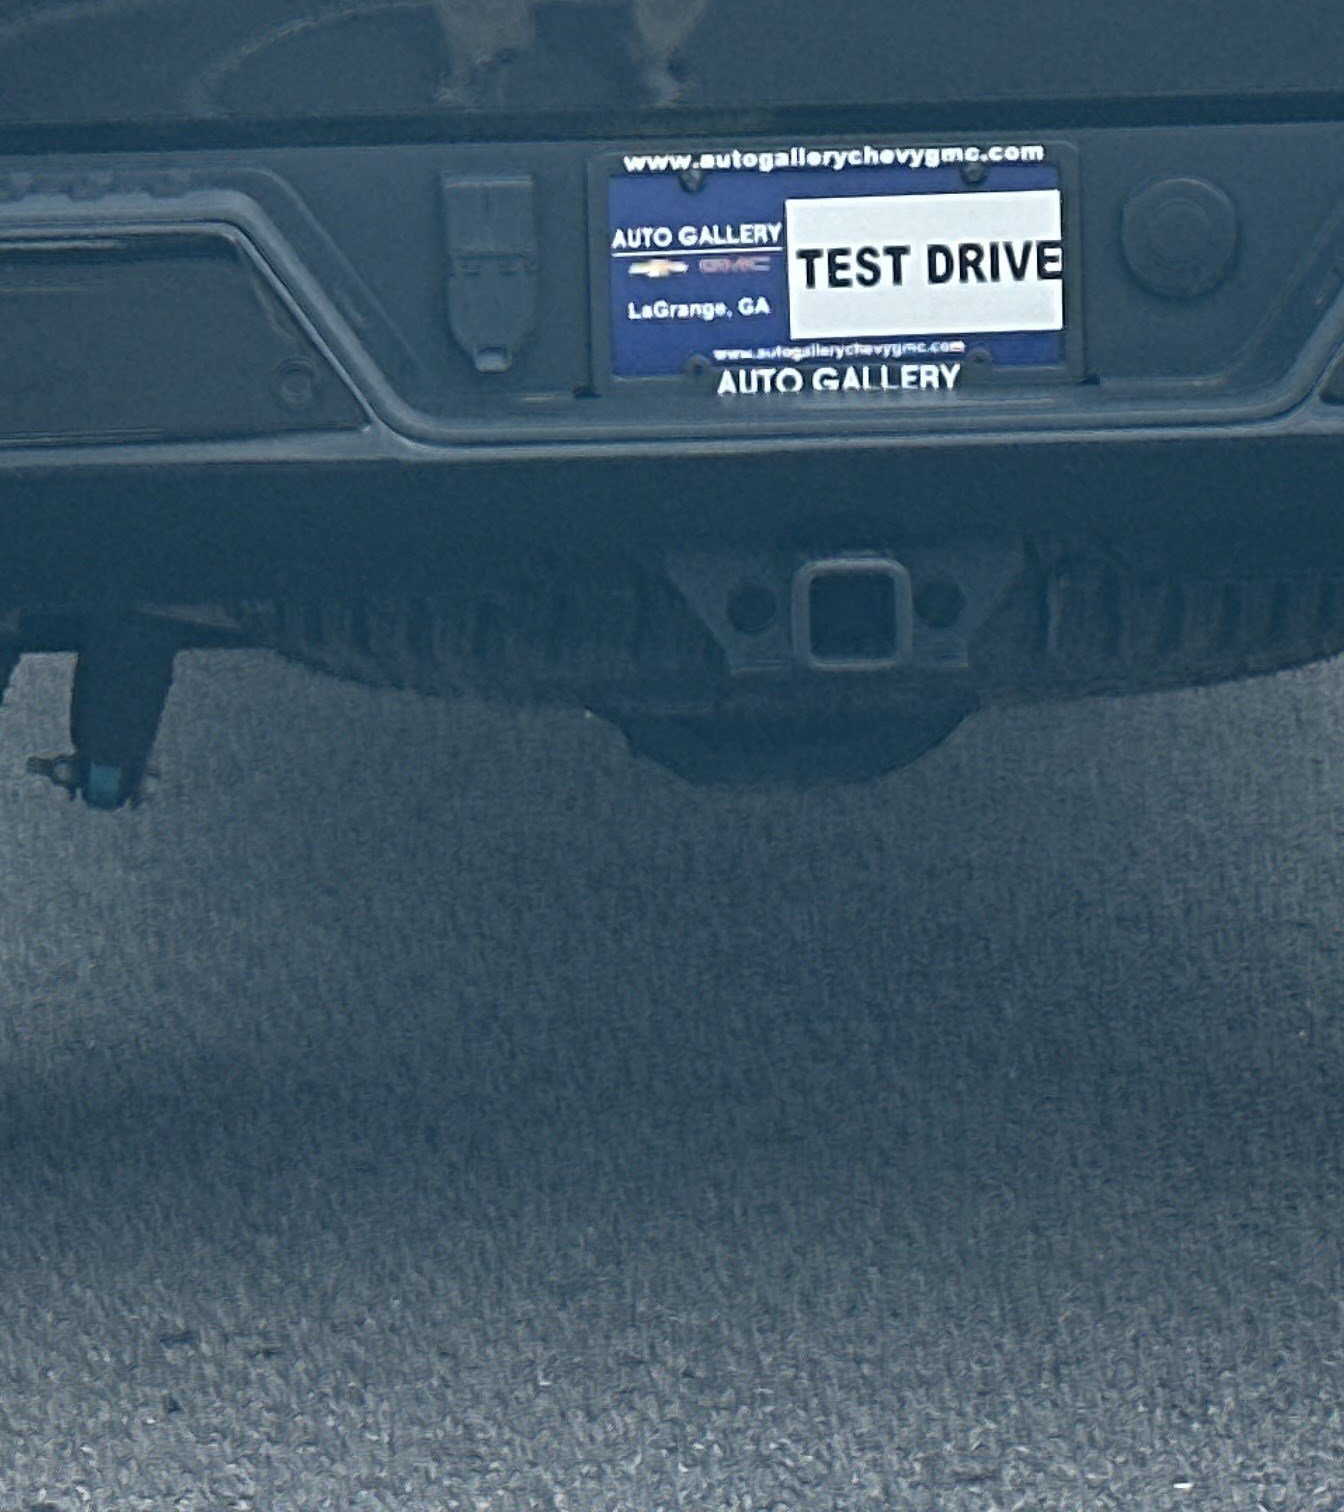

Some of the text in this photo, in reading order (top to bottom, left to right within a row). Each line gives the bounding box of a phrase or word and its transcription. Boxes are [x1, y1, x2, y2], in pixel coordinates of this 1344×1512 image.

[623, 144, 1045, 173] www.autogallerychevygmc.com
[611, 222, 783, 250] AUTO GALLERY
[699, 256, 771, 274] GMC
[795, 238, 1063, 289] TEST DRIVE
[627, 295, 772, 322] LaGrange, GA
[716, 363, 962, 395] AUTO GALLERY
